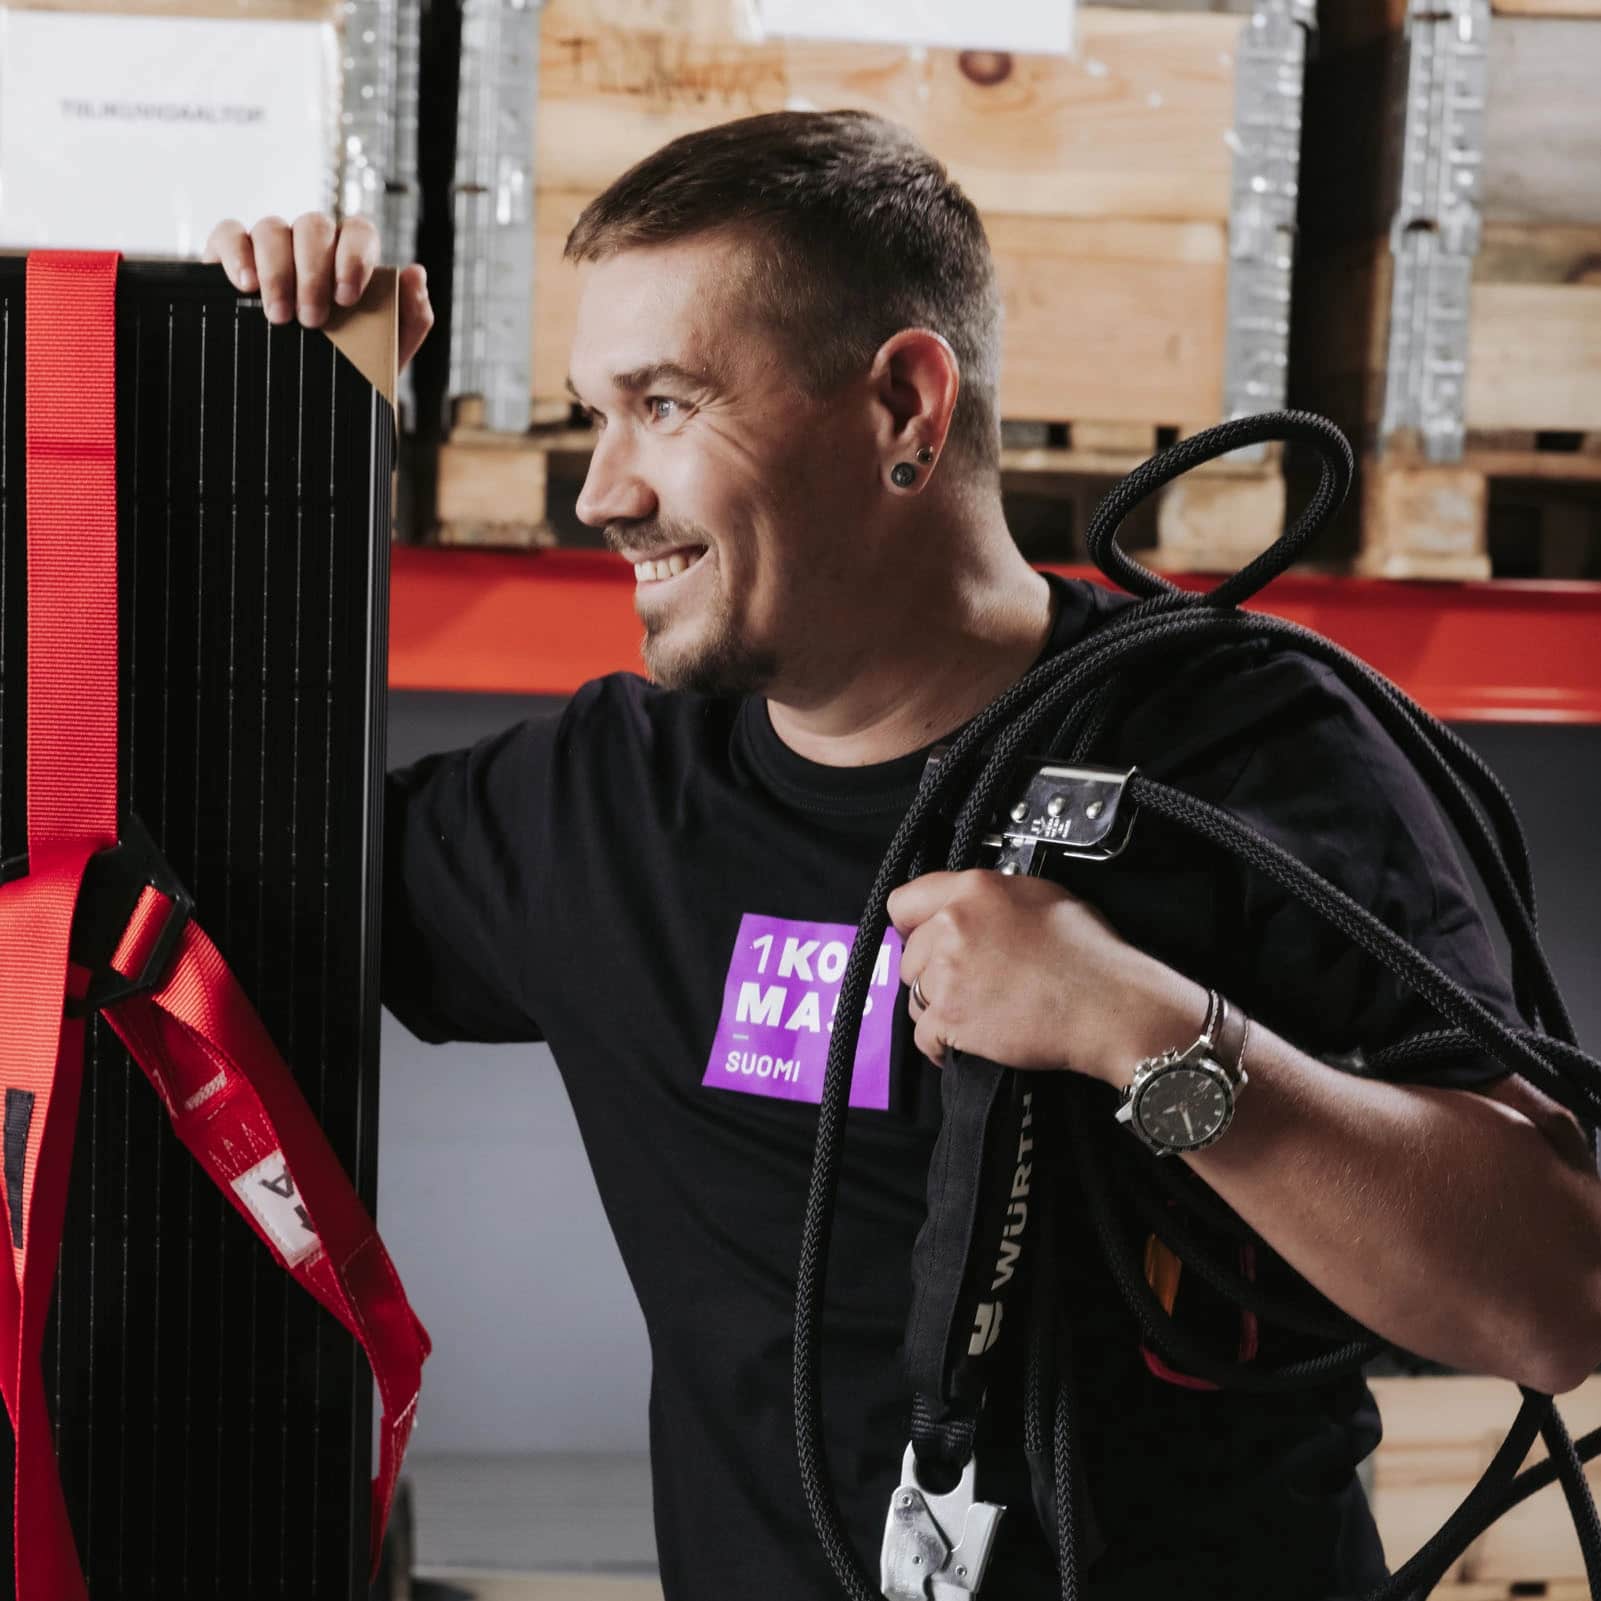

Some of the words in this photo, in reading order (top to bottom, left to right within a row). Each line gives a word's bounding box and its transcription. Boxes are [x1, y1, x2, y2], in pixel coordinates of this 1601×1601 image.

[735, 981, 874, 1034] MA
[725, 1050, 801, 1083] SUOMI
[991, 1091, 1034, 1291] WÜRTH
